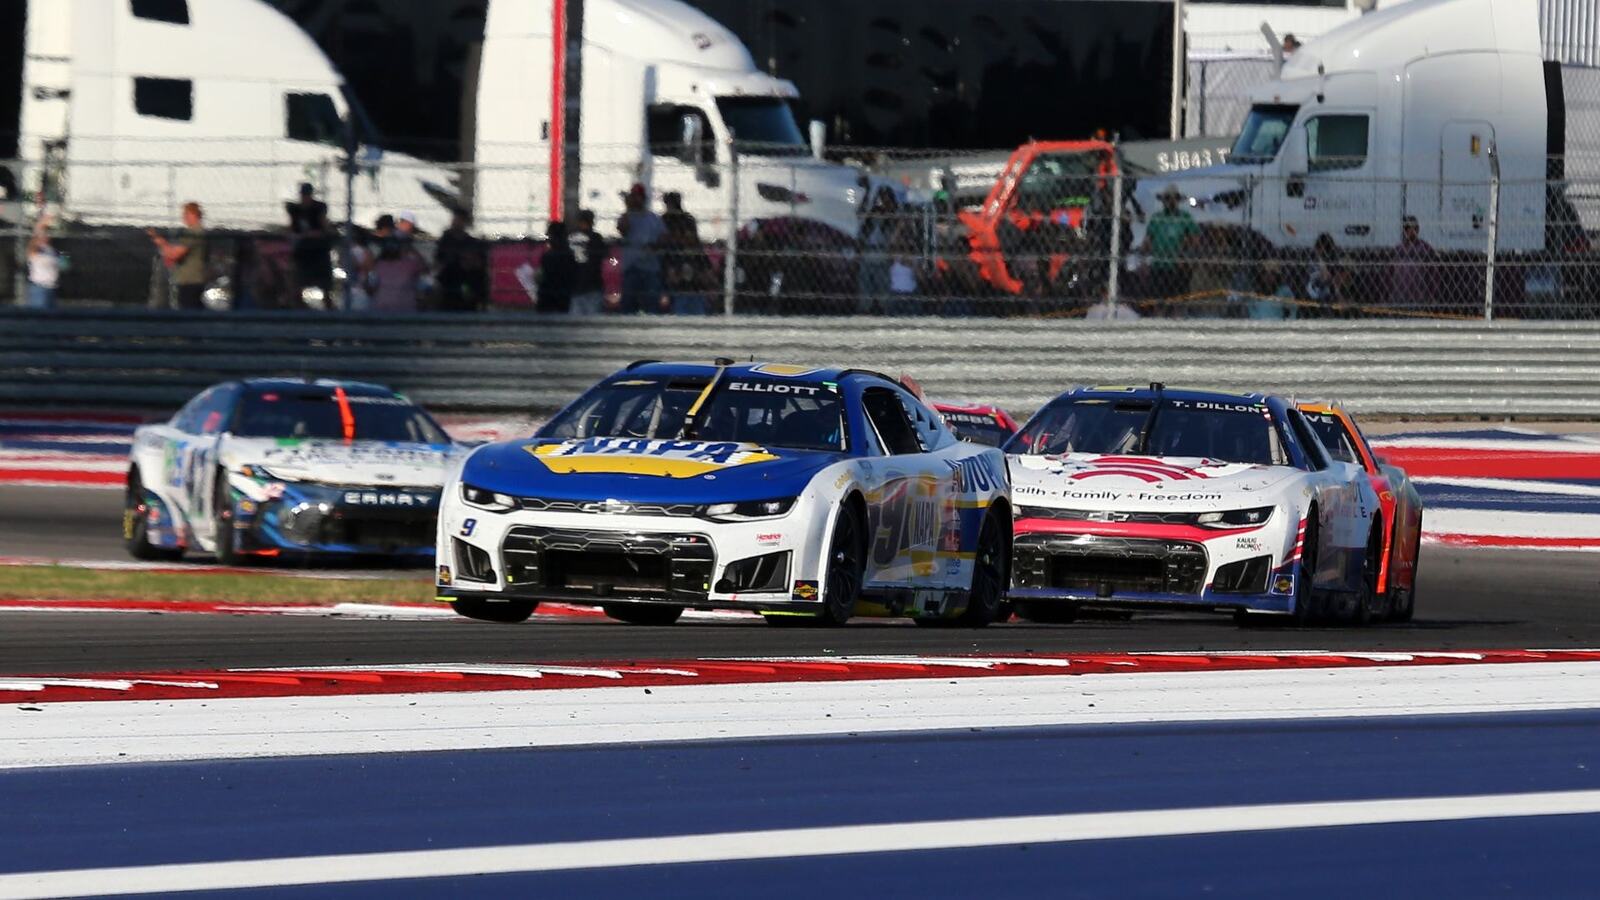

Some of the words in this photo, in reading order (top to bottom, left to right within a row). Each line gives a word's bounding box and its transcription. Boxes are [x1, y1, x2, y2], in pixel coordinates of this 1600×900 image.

[728, 382, 820, 395] ELLIOTT
[1196, 402, 1260, 413] DILLON
[1305, 415, 1334, 424] VE
[562, 438, 740, 463] NAPA
[1062, 490, 1121, 500] Family
[1138, 492, 1222, 501] Freedom
[460, 518, 476, 536] 9
